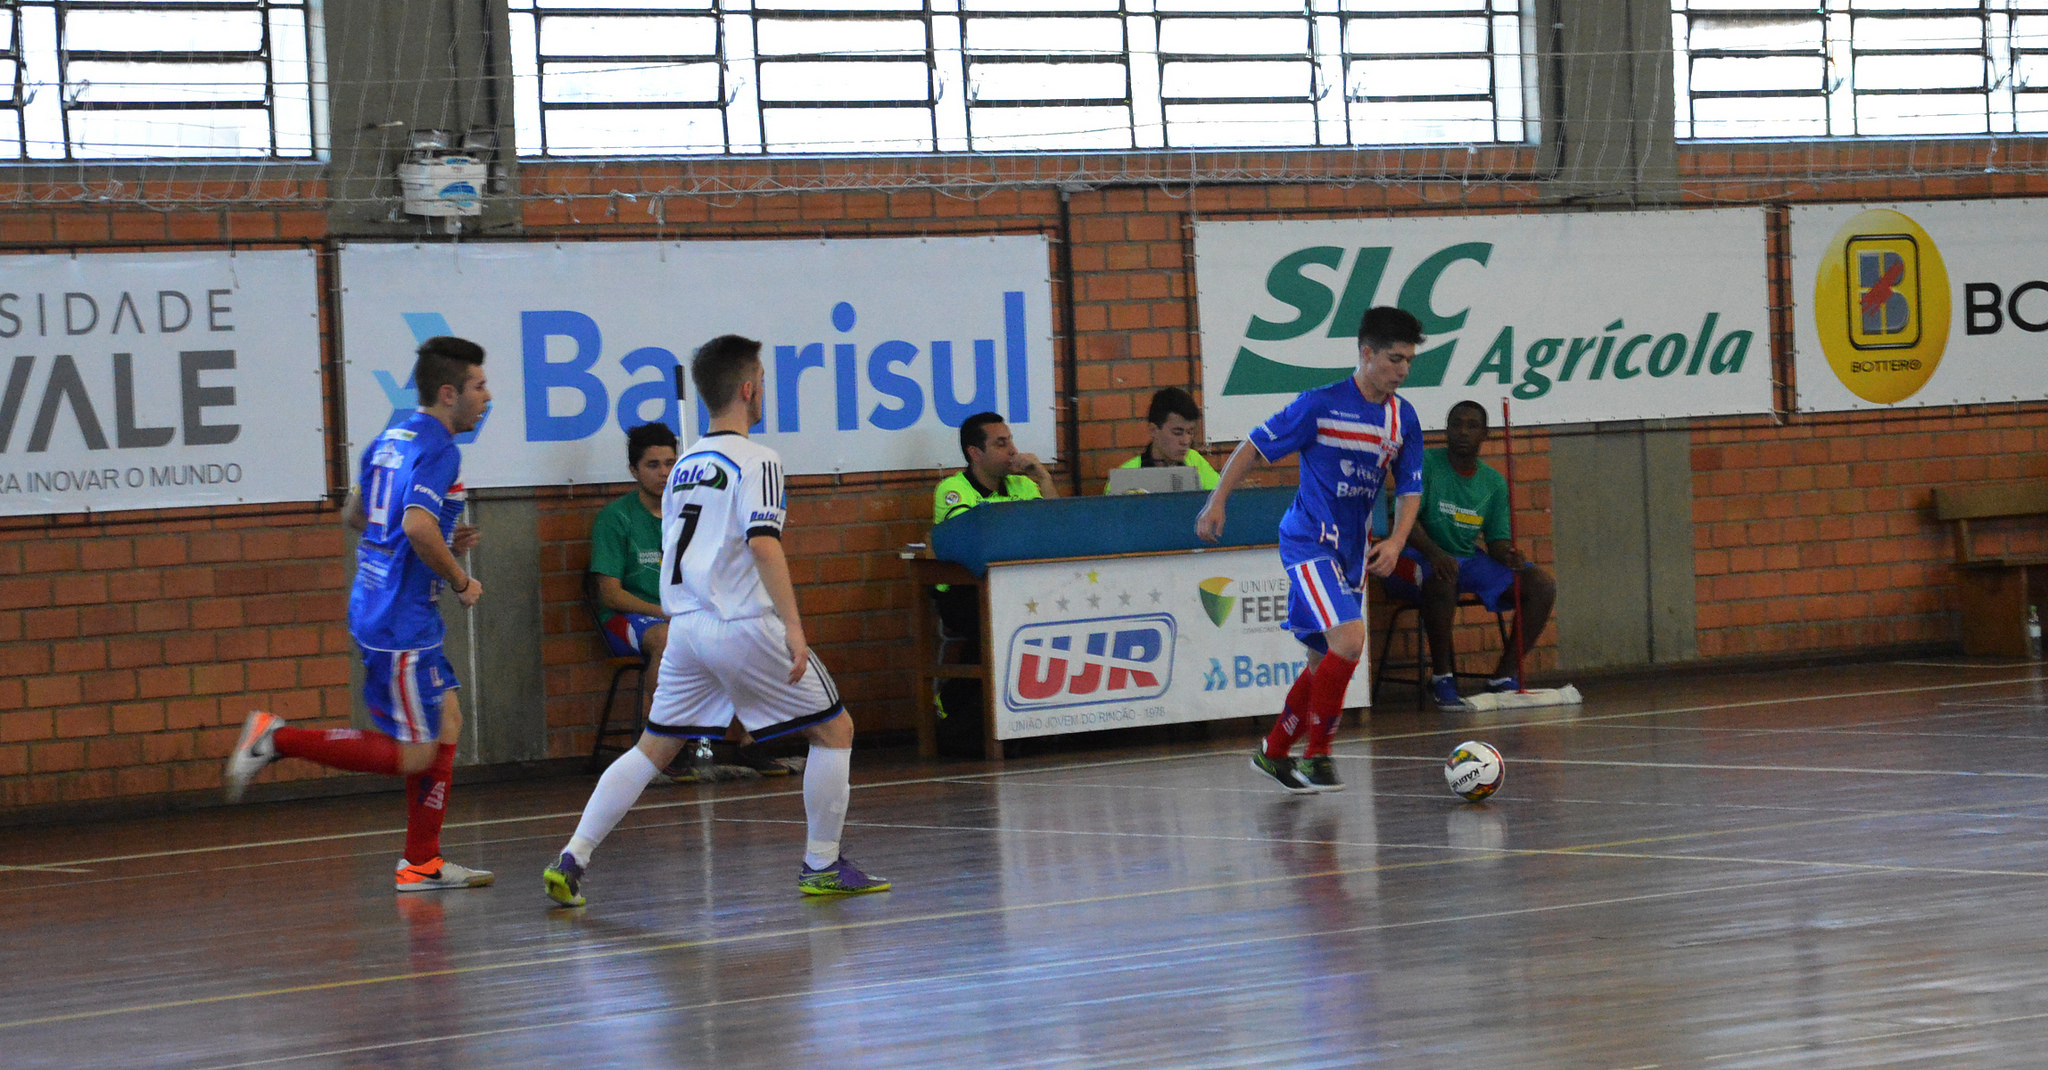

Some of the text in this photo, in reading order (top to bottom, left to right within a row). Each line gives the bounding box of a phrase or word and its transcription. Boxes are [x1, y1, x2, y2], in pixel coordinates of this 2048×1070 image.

[1245, 241, 1495, 341] SLC
[1964, 280, 2048, 335] BO
[520, 291, 1030, 442] Barisul
[1466, 312, 1755, 400] Agrícola
[1851, 359, 1922, 373] BOTTERO
[0, 463, 242, 494] A INOVAR O MUNDO
[1241, 578, 1291, 593] UNIVE
[1017, 627, 1164, 700] UJR
[1234, 655, 1304, 689] Banr
[1012, 717, 1043, 732] UNIÃO
[1046, 714, 1078, 728] JOVEM
[1082, 712, 1096, 725] DO
